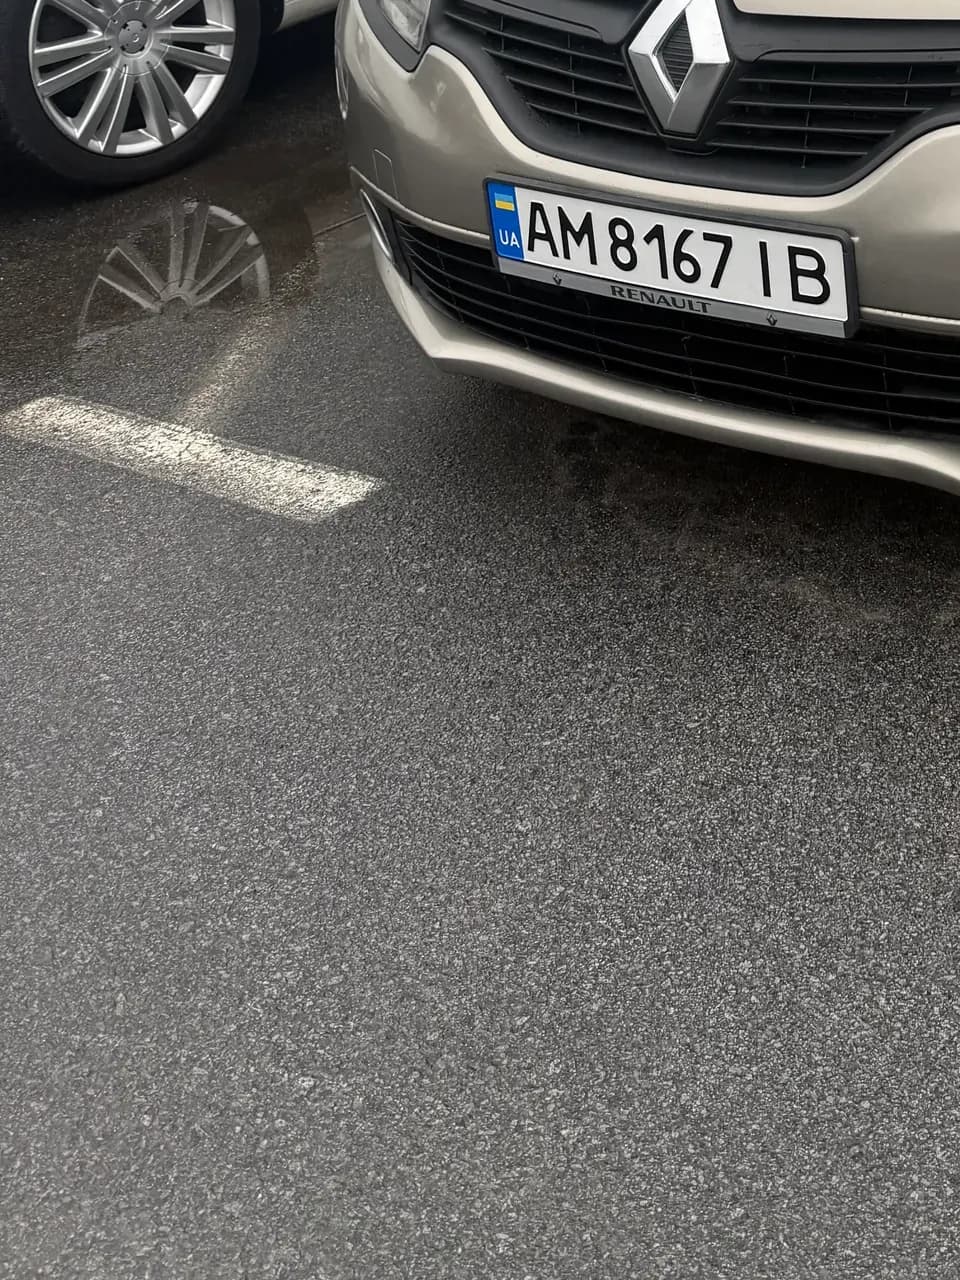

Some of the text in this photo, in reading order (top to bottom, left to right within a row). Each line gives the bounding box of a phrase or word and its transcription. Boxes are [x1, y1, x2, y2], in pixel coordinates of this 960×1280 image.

[499, 228, 520, 248] UA
[527, 201, 831, 305] AM 8167 IB
[610, 285, 712, 313] RENAULT
